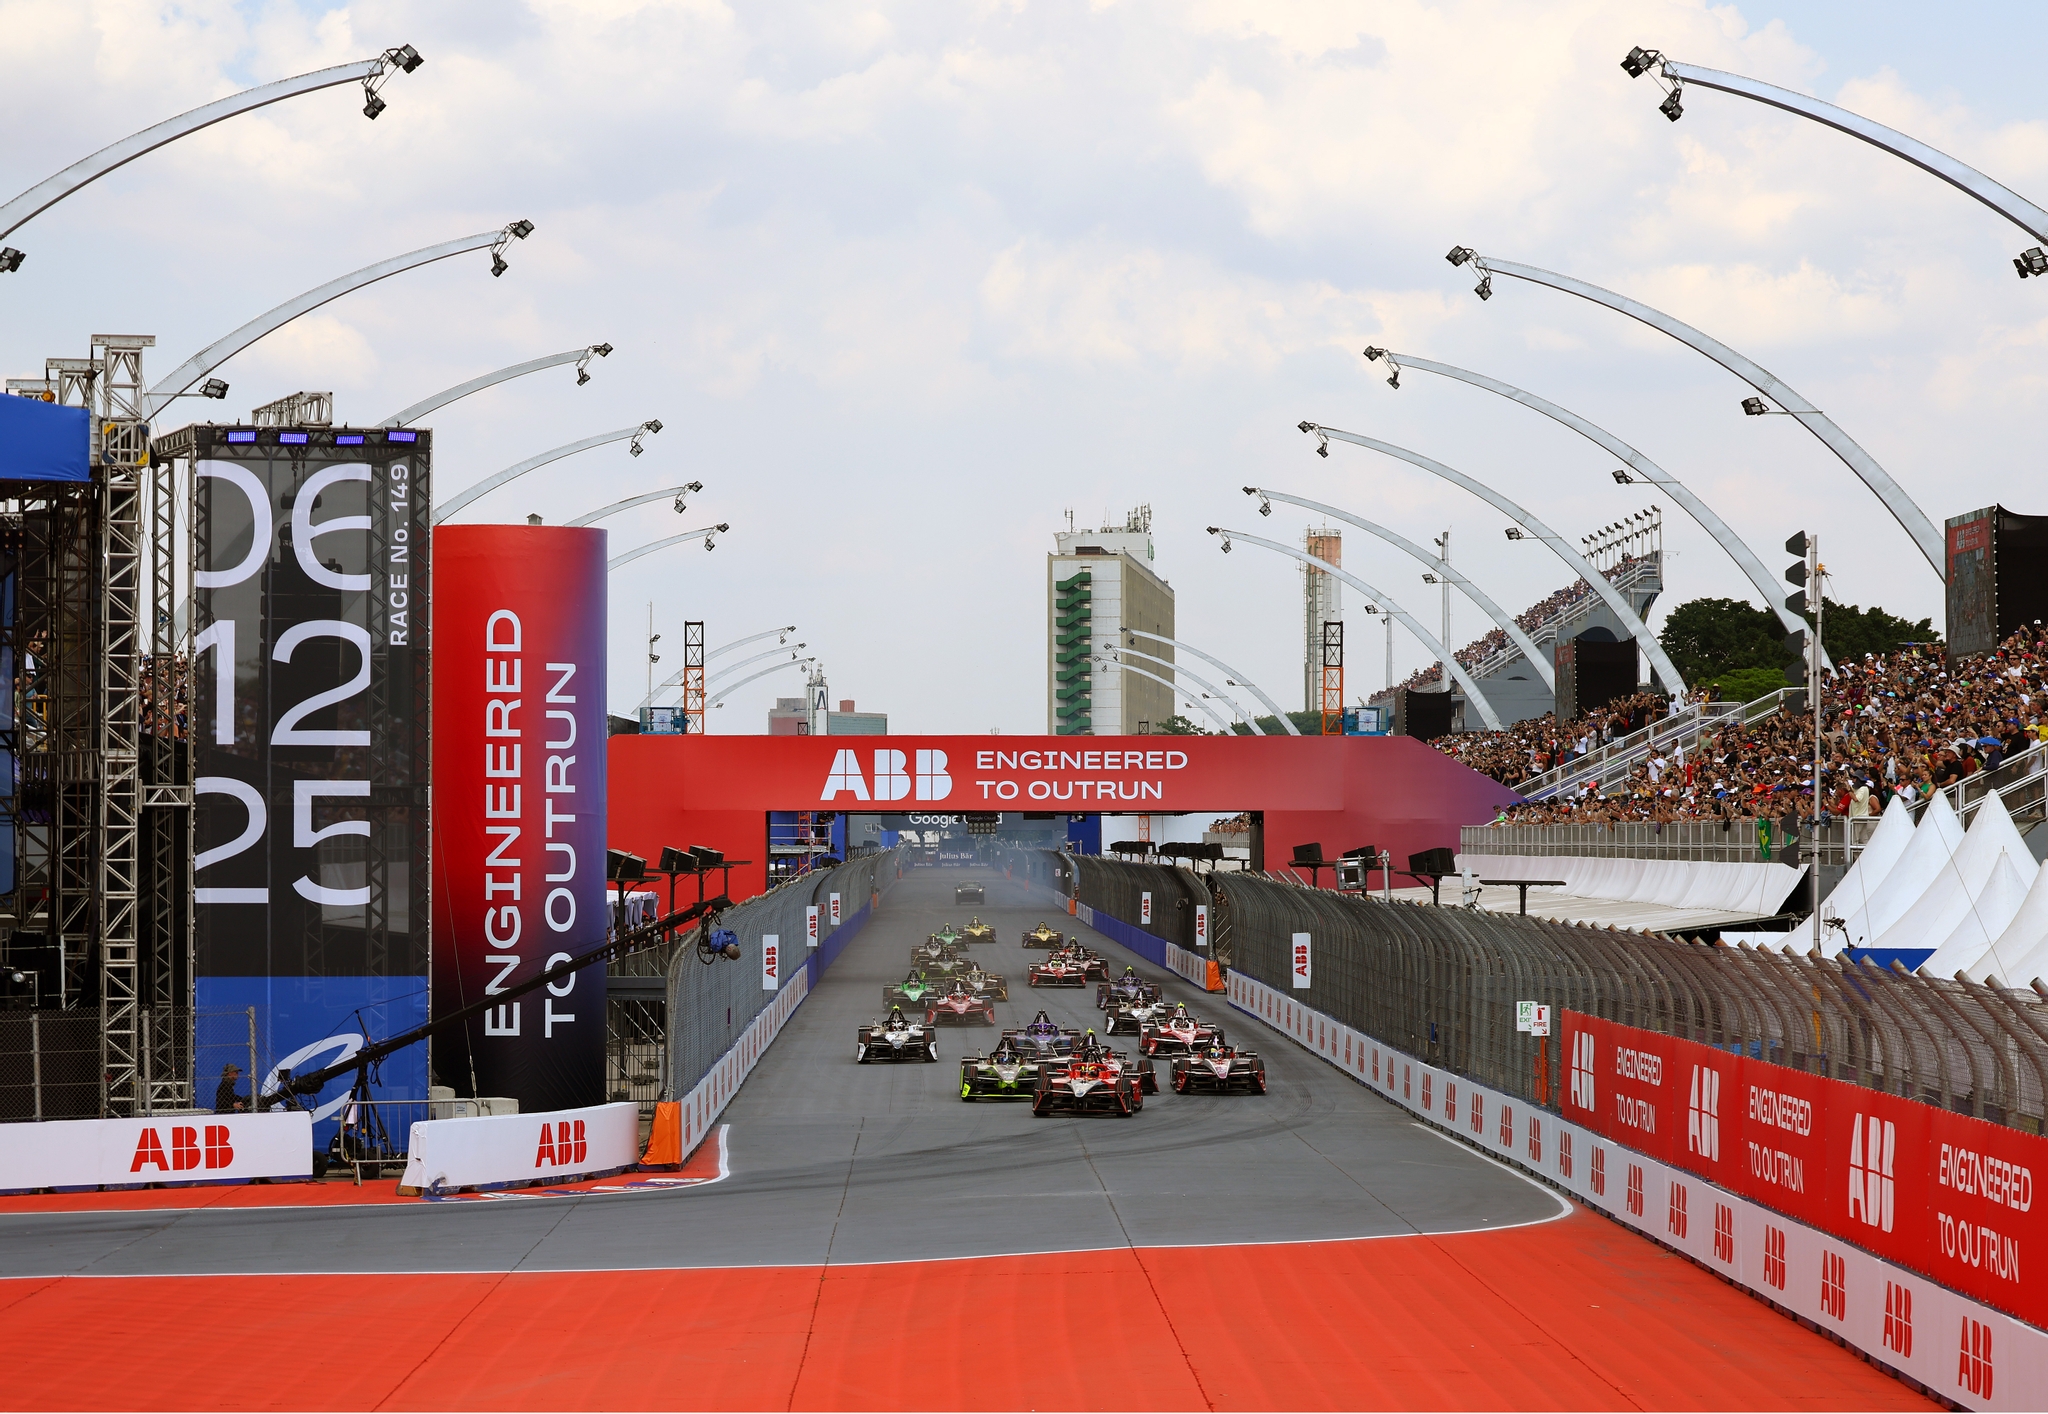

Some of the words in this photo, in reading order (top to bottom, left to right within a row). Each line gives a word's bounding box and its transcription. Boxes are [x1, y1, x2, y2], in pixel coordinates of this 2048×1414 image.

[390, 464, 409, 512] 149
[390, 522, 409, 563] No.
[390, 574, 408, 646] RACE
[195, 619, 371, 746] 12
[820, 749, 953, 800] ABB
[976, 750, 1188, 770] ENGINEERED
[545, 662, 577, 933] OUTRUN
[976, 780, 1018, 800] TO
[1028, 780, 1162, 800] OUTRUN
[193, 776, 371, 906] 25
[485, 609, 522, 1037] ENGINEERED
[939, 852, 959, 861] Julius
[960, 852, 973, 860] Bär
[809, 914, 817, 938] ABB
[1197, 913, 1205, 937] ABB
[765, 946, 777, 978] ABB
[1295, 944, 1308, 977] ABB
[545, 952, 576, 1038] TO
[1571, 1030, 1595, 1112] ABB
[1616, 1046, 1662, 1087] ENGINEERED
[1445, 1082, 1457, 1122] ABB
[1471, 1092, 1483, 1134] ABB
[1500, 1105, 1513, 1148] ABB
[1616, 1093, 1626, 1124] TO
[1626, 1096, 1656, 1134] OUTRUN
[1688, 1064, 1720, 1163] ABB
[1749, 1085, 1812, 1137] ENGINEERED
[129, 1125, 234, 1173] ABB
[535, 1119, 588, 1169] ABB
[1529, 1116, 1541, 1163] ABB
[1560, 1130, 1573, 1179] ABB
[1591, 1145, 1605, 1197] ABB
[1627, 1163, 1644, 1218] ABB
[1748, 1141, 1761, 1178] TO
[1762, 1146, 1804, 1194] OUTRUN
[1848, 1112, 1896, 1233] ABB
[1939, 1143, 2032, 1213] ENGINEERED
[1669, 1181, 1688, 1239] ABB
[1714, 1202, 1733, 1265] ABB
[1763, 1223, 1786, 1292] ABB
[1938, 1211, 1956, 1259] TO
[1958, 1219, 2019, 1284] OUTRUN
[1821, 1249, 1846, 1321] ABB
[1883, 1280, 1913, 1359] ABB
[1957, 1314, 1995, 1402] ABB
